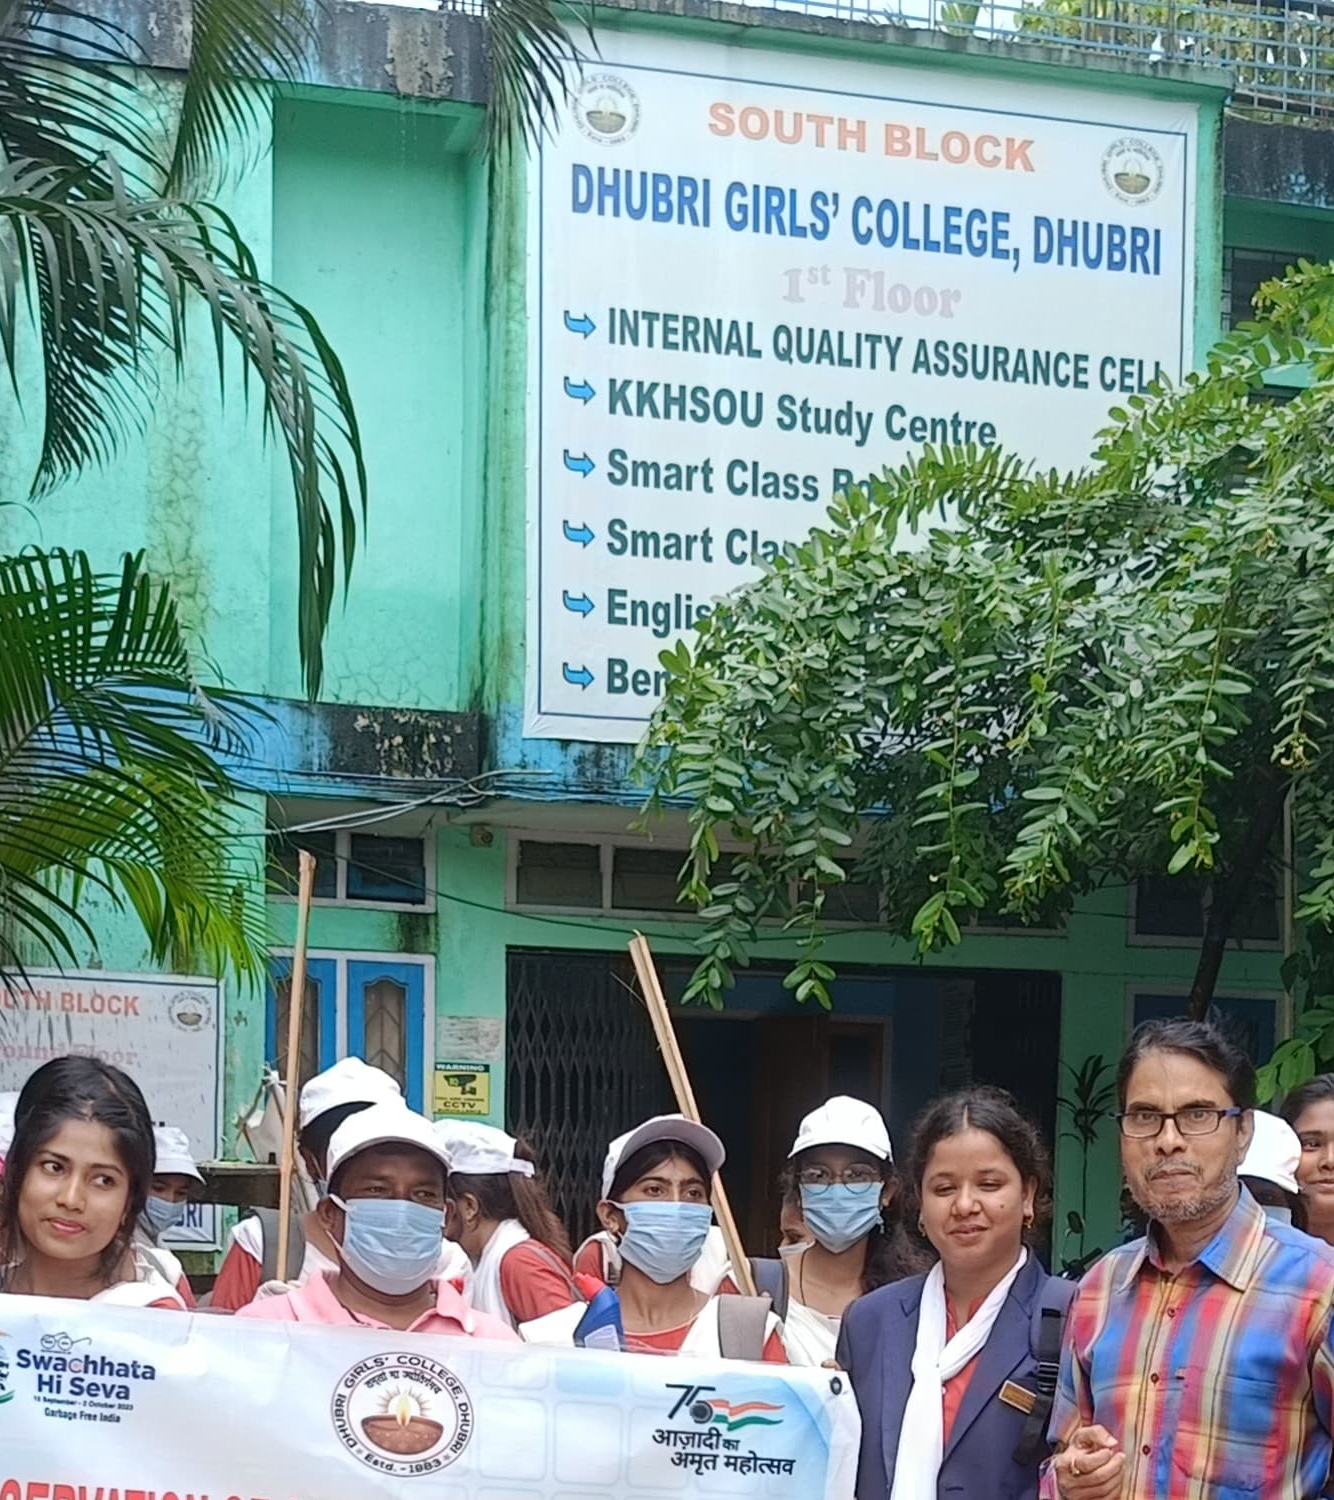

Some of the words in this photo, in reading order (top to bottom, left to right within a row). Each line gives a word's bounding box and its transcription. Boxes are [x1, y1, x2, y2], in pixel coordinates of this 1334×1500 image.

[708, 102, 867, 152] SOUTH
[884, 122, 1035, 173] BLOCK
[571, 162, 711, 228] DHUBRI
[851, 196, 1020, 273] COLLEGE,
[1033, 216, 1162, 276] DHUBRI
[782, 263, 831, 303] 1st
[843, 266, 962, 319] Floor
[608, 308, 762, 360] INTERNAL
[772, 325, 903, 374] QUALITY
[912, 338, 1089, 389] ASSURANCE
[608, 378, 763, 429] KKHSOU
[776, 392, 873, 447] Study
[885, 405, 998, 449] Centre
[607, 448, 713, 494] Smart
[726, 459, 819, 502] Class
[607, 518, 713, 563] Smart
[61, 991, 140, 1017] BLOCK
[443, 1101, 476, 1109] CCTV
[16, 1349, 156, 1381] Swachhata
[37, 1373, 62, 1395] Hi
[69, 1376, 131, 1401] Seva
[44, 1407, 77, 1421] Garbage
[79, 1410, 98, 1422] Free
[100, 1412, 121, 1423] India
[334, 1393, 358, 1449] DHUBRI
[397, 1355, 463, 1400] COLLEGE,
[449, 1402, 471, 1454] DHUBRI
[652, 1426, 722, 1450] आज़ादी
[722, 1438, 741, 1451] का
[671, 1451, 719, 1476] अमृत
[723, 1450, 796, 1476] महोत्सव
